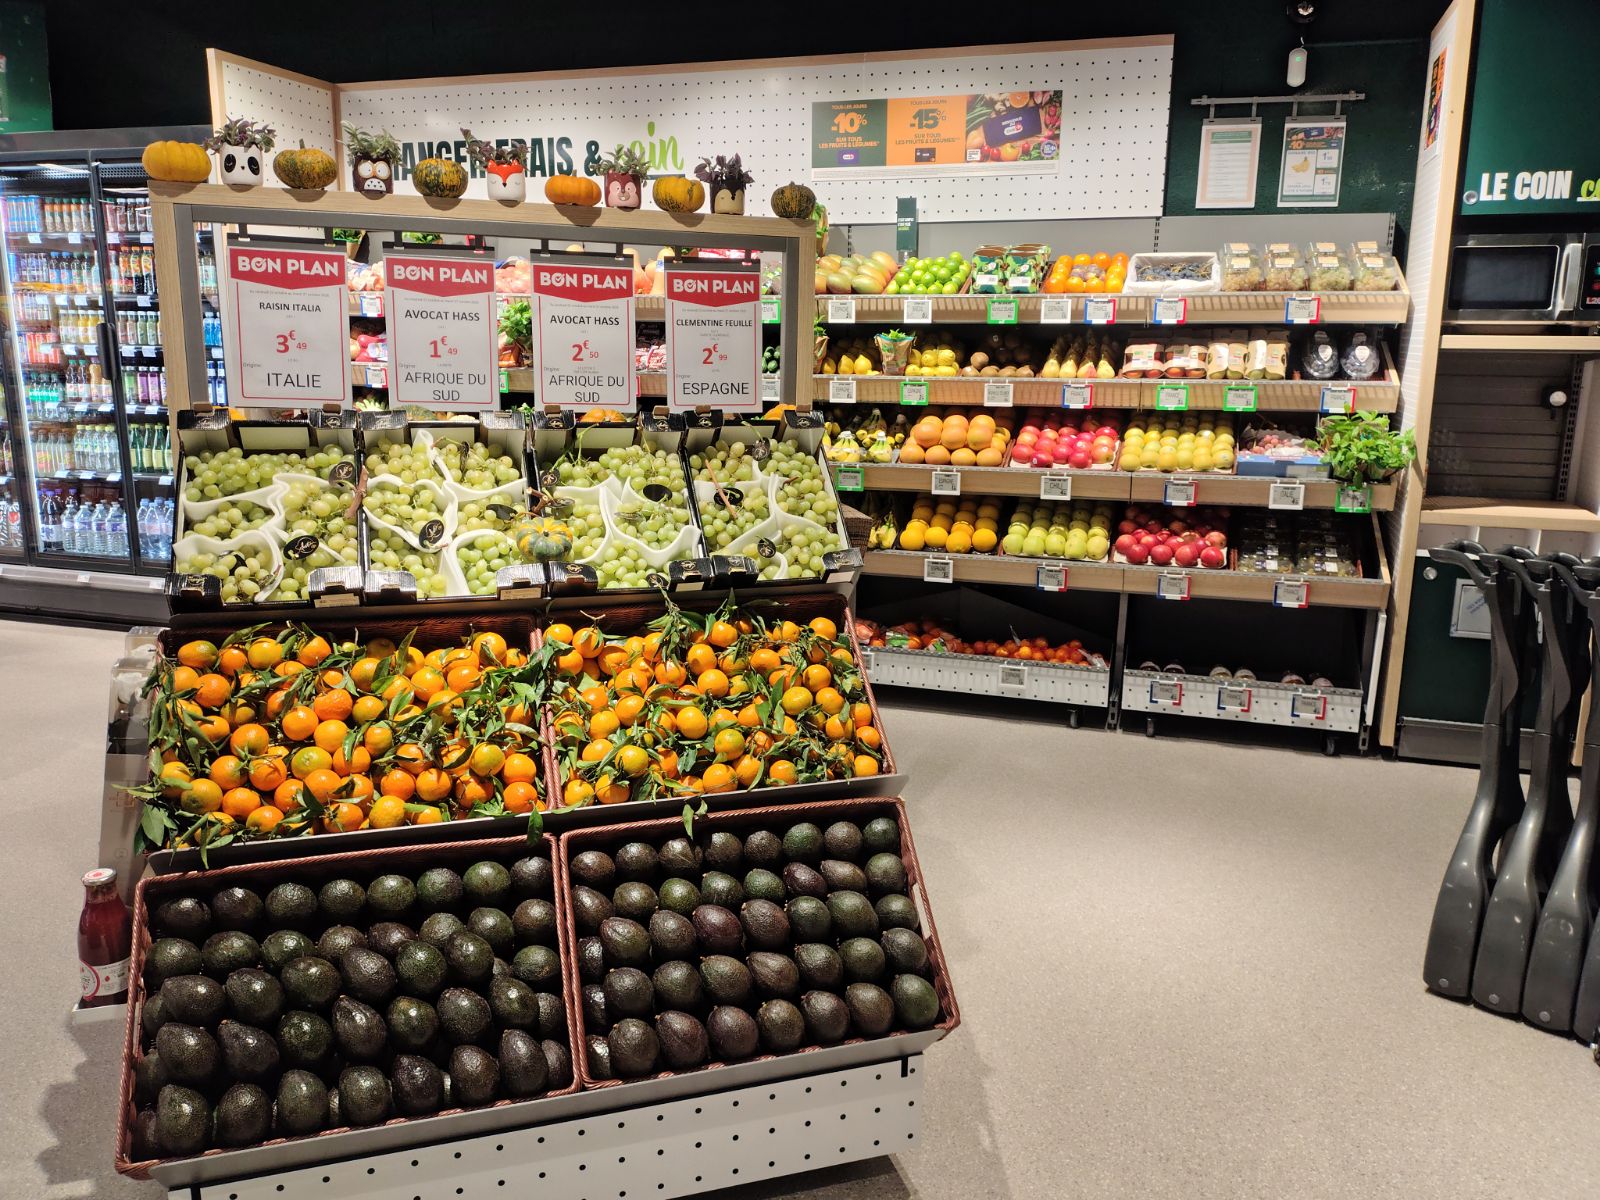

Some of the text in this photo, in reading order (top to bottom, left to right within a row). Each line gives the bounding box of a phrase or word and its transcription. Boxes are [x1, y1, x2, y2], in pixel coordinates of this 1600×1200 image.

[832, 112, 868, 134] -10%
[1480, 172, 1508, 200] LE
[1514, 170, 1572, 200] COIN
[238, 256, 338, 276] BON PLAN
[394, 265, 488, 284] BON PLAN
[540, 272, 627, 290] BON PLAN
[673, 278, 754, 294] BON PLAN
[260, 302, 322, 312] RAISIN ITALIA
[404, 309, 480, 322] AVOCAT HASS
[550, 315, 620, 326] AVOCAT HASS
[676, 319, 724, 327] CLEMENTINE
[267, 372, 322, 388] ITALIE
[404, 372, 486, 385] AFRIQUE DU
[549, 374, 624, 388] AFRIQUE DU
[432, 390, 460, 400] SUD
[682, 382, 750, 395] ESPAGNE
[574, 392, 600, 403] SUD
